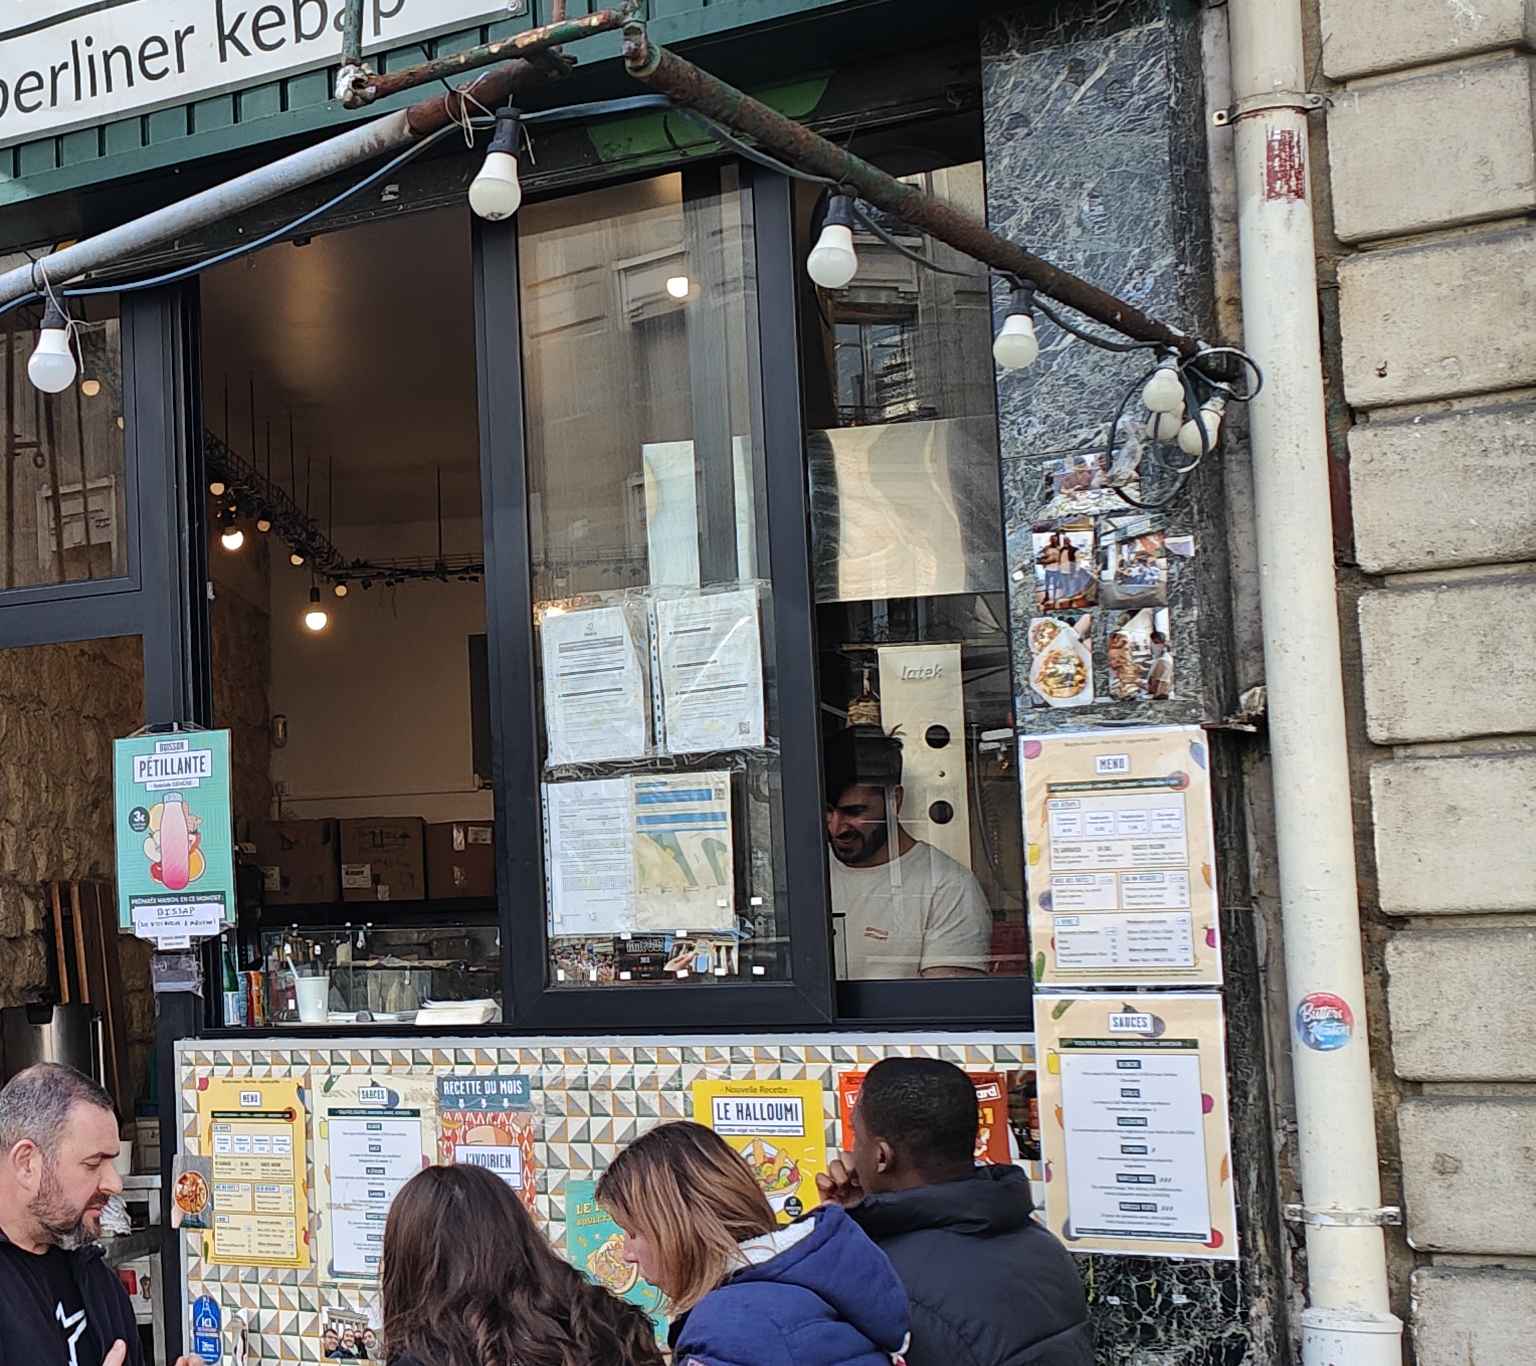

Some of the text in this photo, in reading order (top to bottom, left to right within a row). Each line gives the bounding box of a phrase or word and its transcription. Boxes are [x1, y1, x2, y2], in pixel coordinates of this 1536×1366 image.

[139, 755, 206, 778] PÉTILLANTE
[1099, 758, 1125, 771] MENU
[1112, 1016, 1149, 1029] SAUCES
[443, 1079, 523, 1095] RECETTE DU MOIS
[725, 1085, 788, 1094] Nouvelle Recette
[361, 1089, 385, 1100] SAUCES
[716, 1102, 799, 1122] LE HALLOUMI
[465, 1152, 512, 1169] L'IVOIRIEN
[576, 1202, 591, 1215] LE
